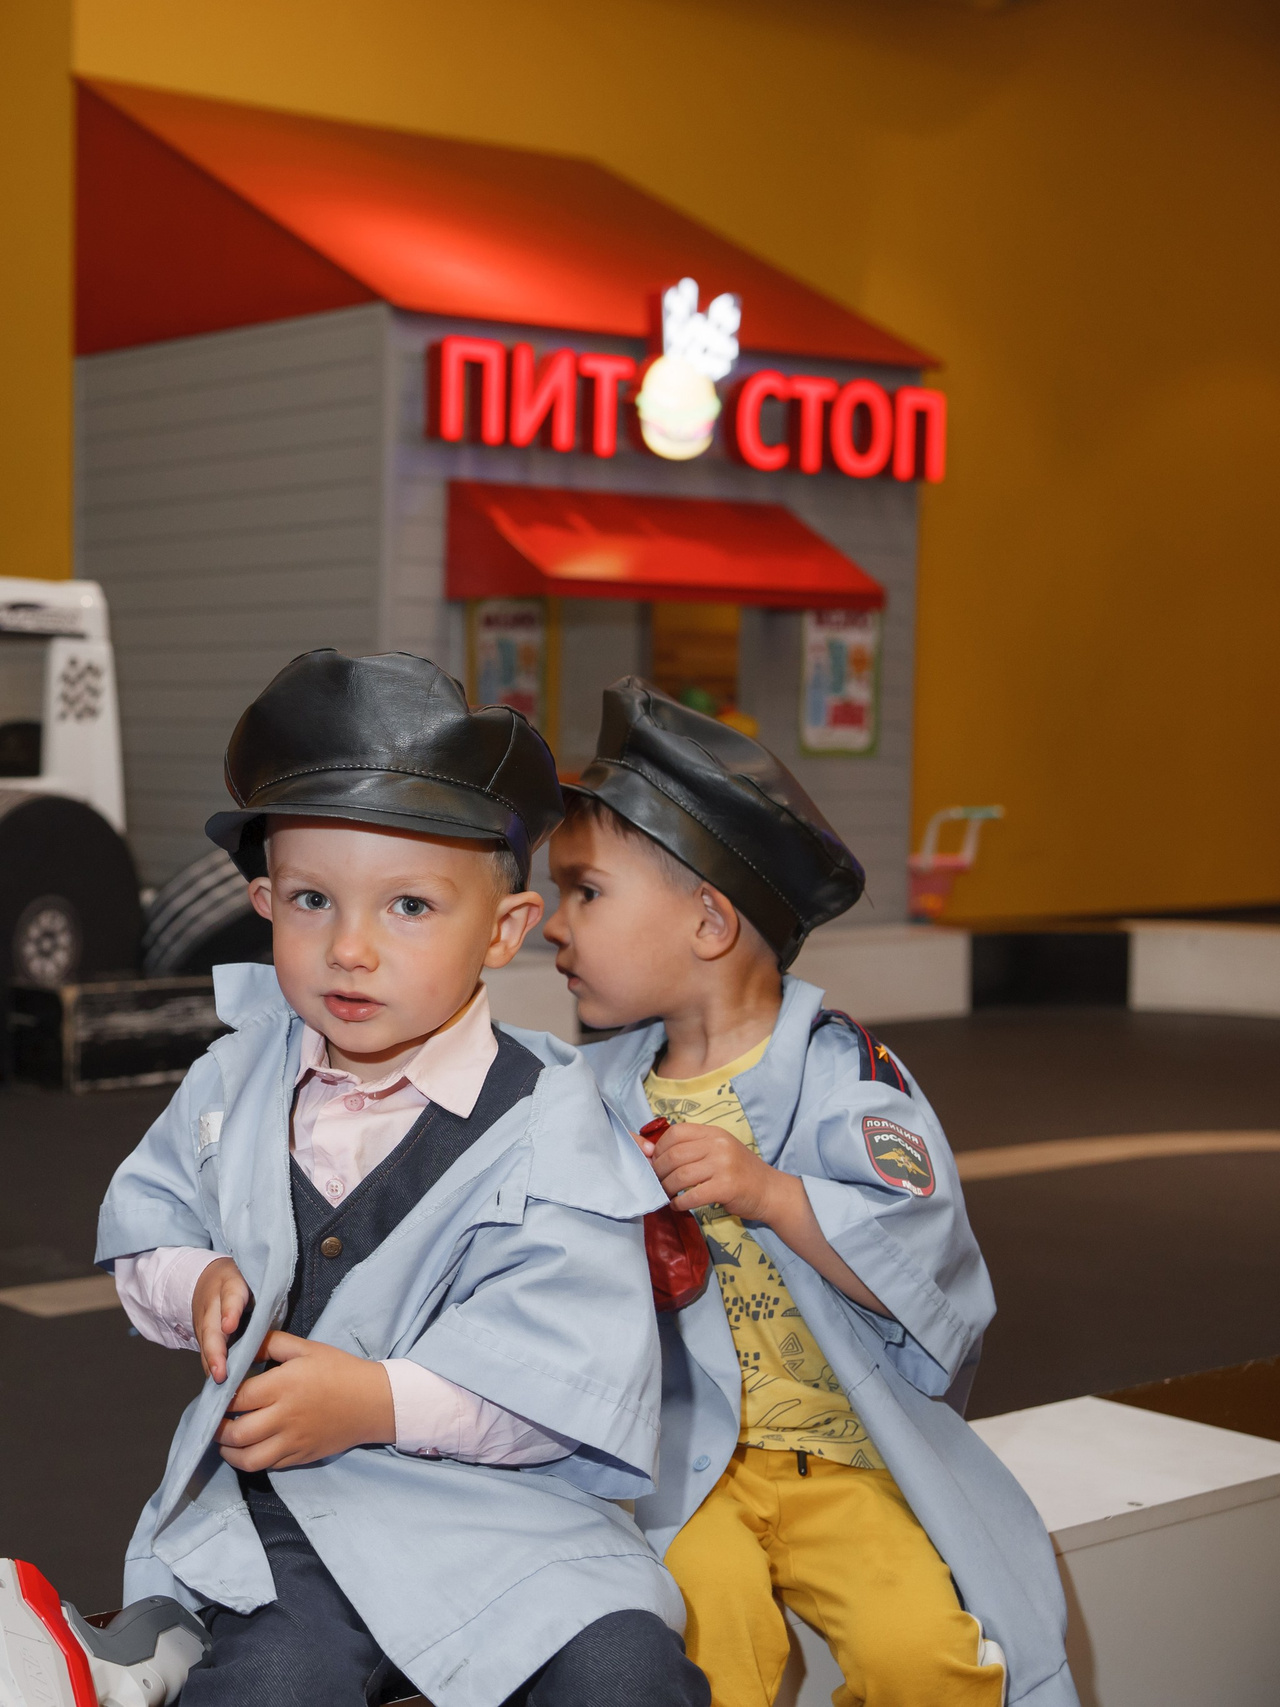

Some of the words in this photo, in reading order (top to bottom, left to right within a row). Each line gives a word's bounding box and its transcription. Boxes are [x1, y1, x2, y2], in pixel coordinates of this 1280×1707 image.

[434, 334, 637, 460] ПИТ
[734, 369, 948, 484] СТОП
[866, 1120, 919, 1145] ПОЛИЦИЯ
[873, 1133, 922, 1162] РОССИЯ
